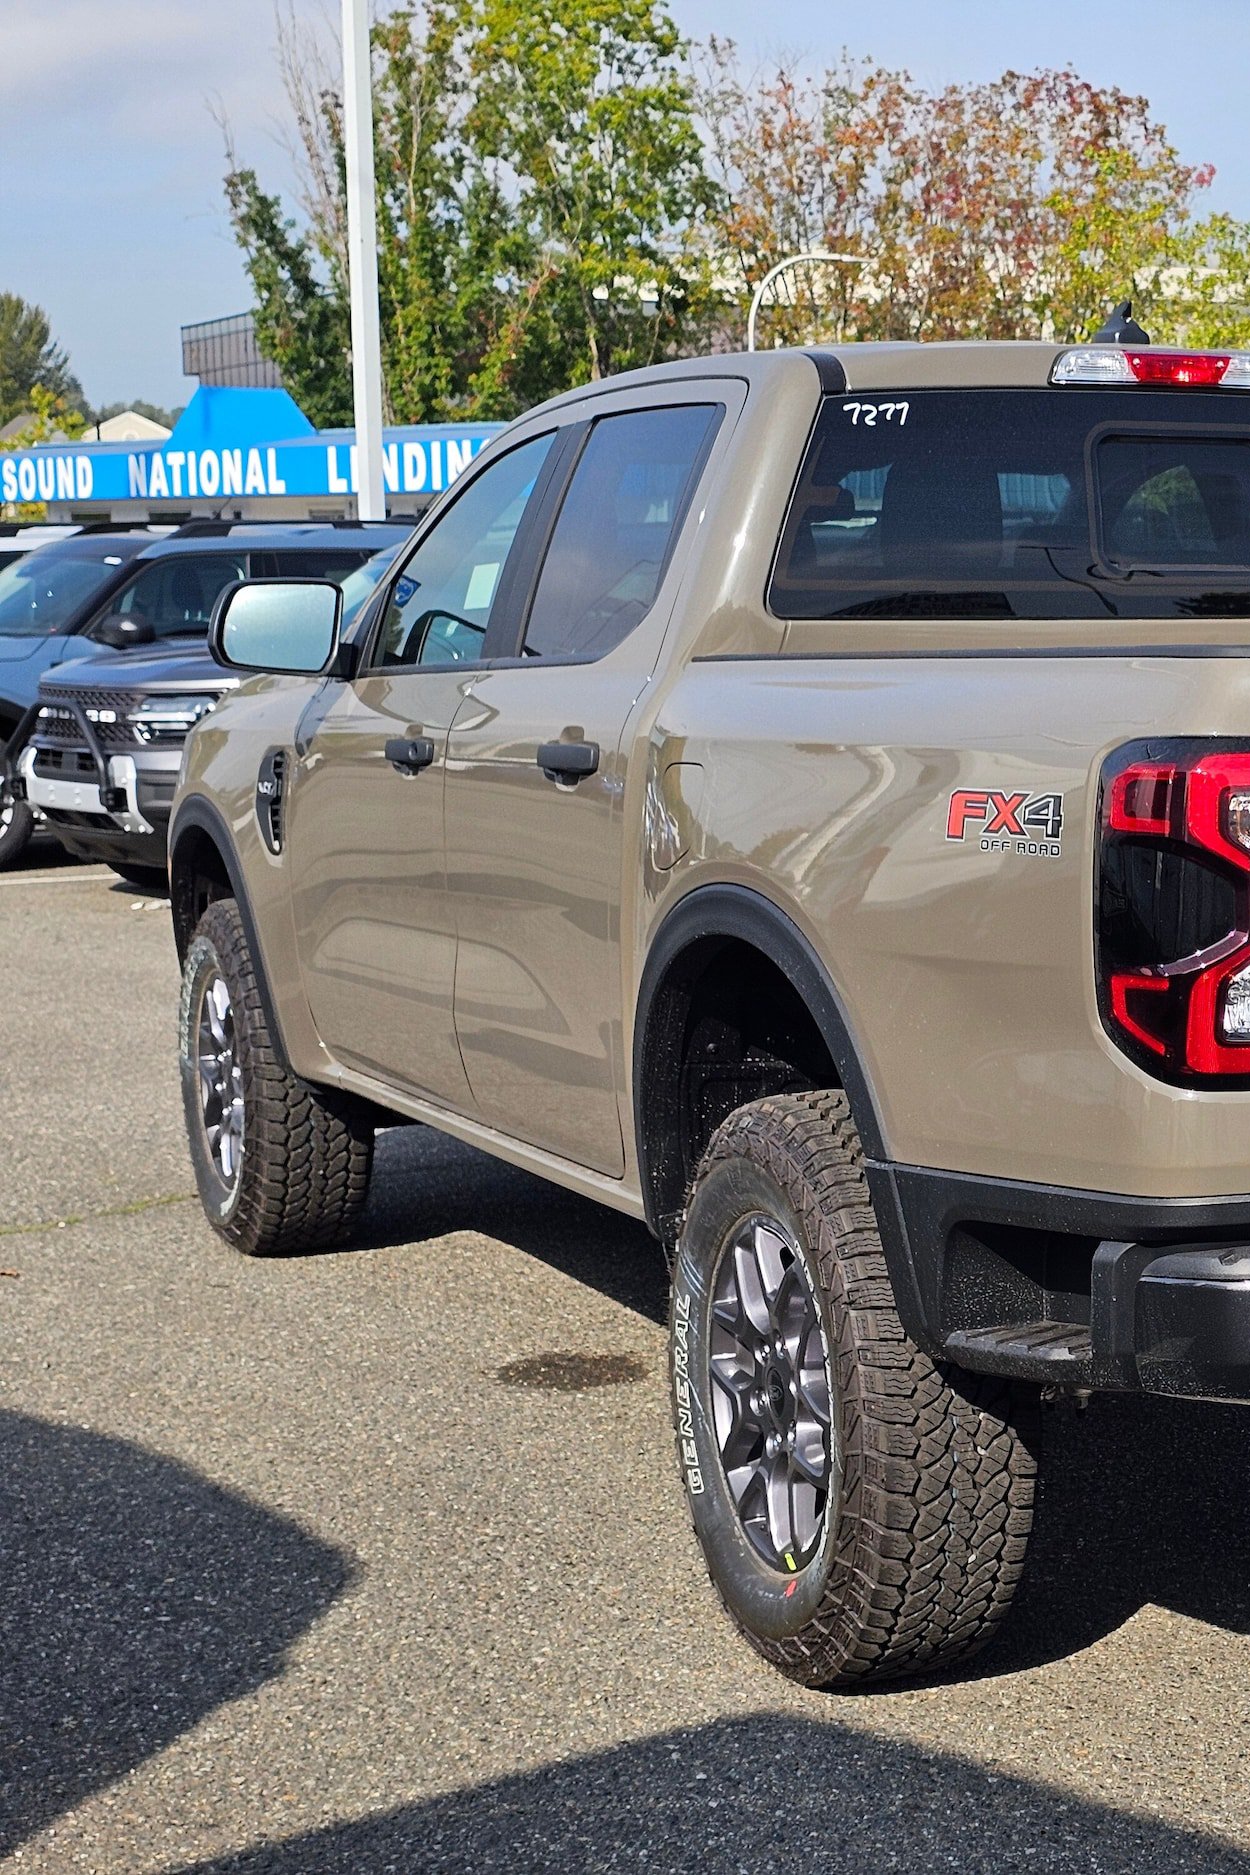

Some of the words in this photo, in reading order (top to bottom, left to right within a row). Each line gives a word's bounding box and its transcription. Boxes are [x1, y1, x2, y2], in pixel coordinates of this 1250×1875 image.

[843, 402, 909, 426] 7277
[2, 455, 94, 499] SOUND
[128, 447, 287, 497] NATIONAL
[945, 787, 1064, 841] FX4
[980, 839, 1011, 853] OFF
[1016, 842, 1061, 858] ROAD
[674, 1294, 705, 1494] GENERAL
